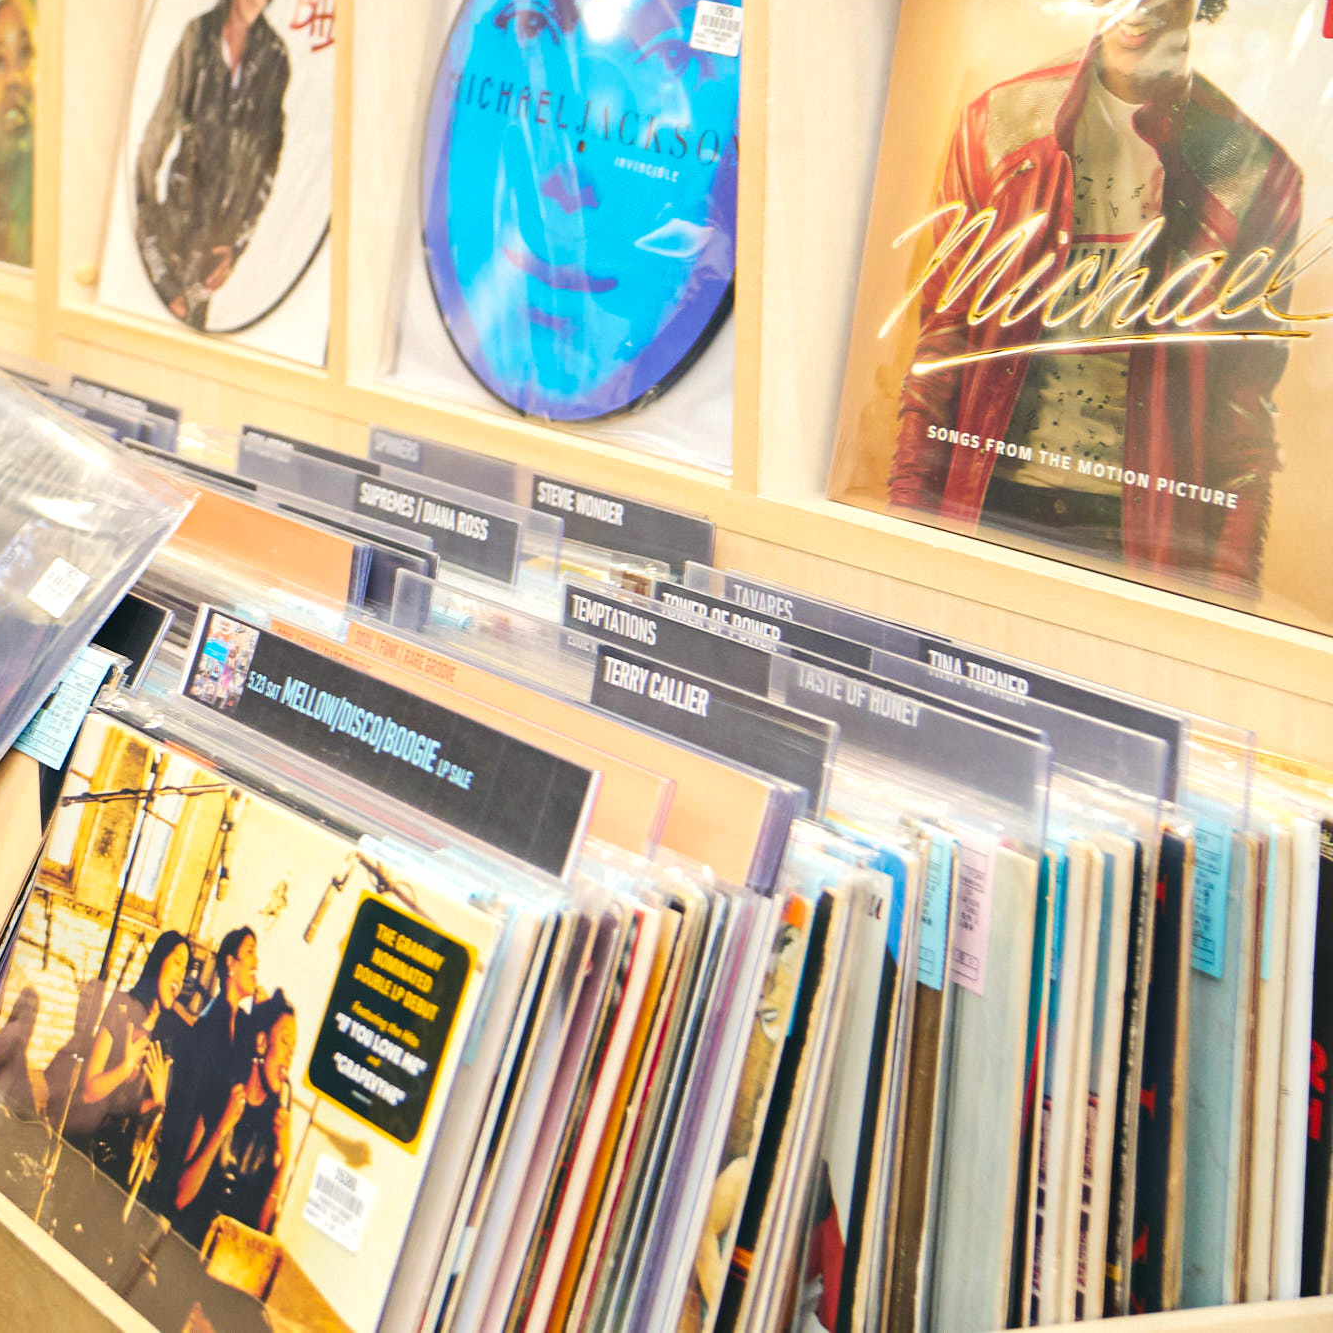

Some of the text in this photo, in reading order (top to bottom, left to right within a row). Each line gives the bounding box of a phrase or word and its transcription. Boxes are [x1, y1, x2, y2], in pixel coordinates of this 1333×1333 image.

[450, 71, 568, 130] MICHAEL
[877, 200, 1333, 339] Michael
[927, 424, 1239, 509] SONGS FROM THE MOTION PICTURE
[359, 481, 415, 518] SUPREMES
[422, 500, 456, 531] DIANA
[457, 511, 489, 541] ROSS
[537, 481, 624, 526] STEVIE WONDER
[571, 594, 658, 647] TEMPTATIONS
[733, 583, 794, 621] TAVARES
[404, 648, 426, 671] RARE
[425, 657, 457, 684] GROOVE
[603, 655, 710, 717] TERRY CALLIER
[246, 670, 268, 695] 5.23
[266, 680, 282, 702] SAT
[436, 758, 452, 779] LP
[448, 764, 475, 791] SALE
[375, 922, 398, 949] THE
[353, 963, 440, 1022] DOUBLE LP DEBUT
